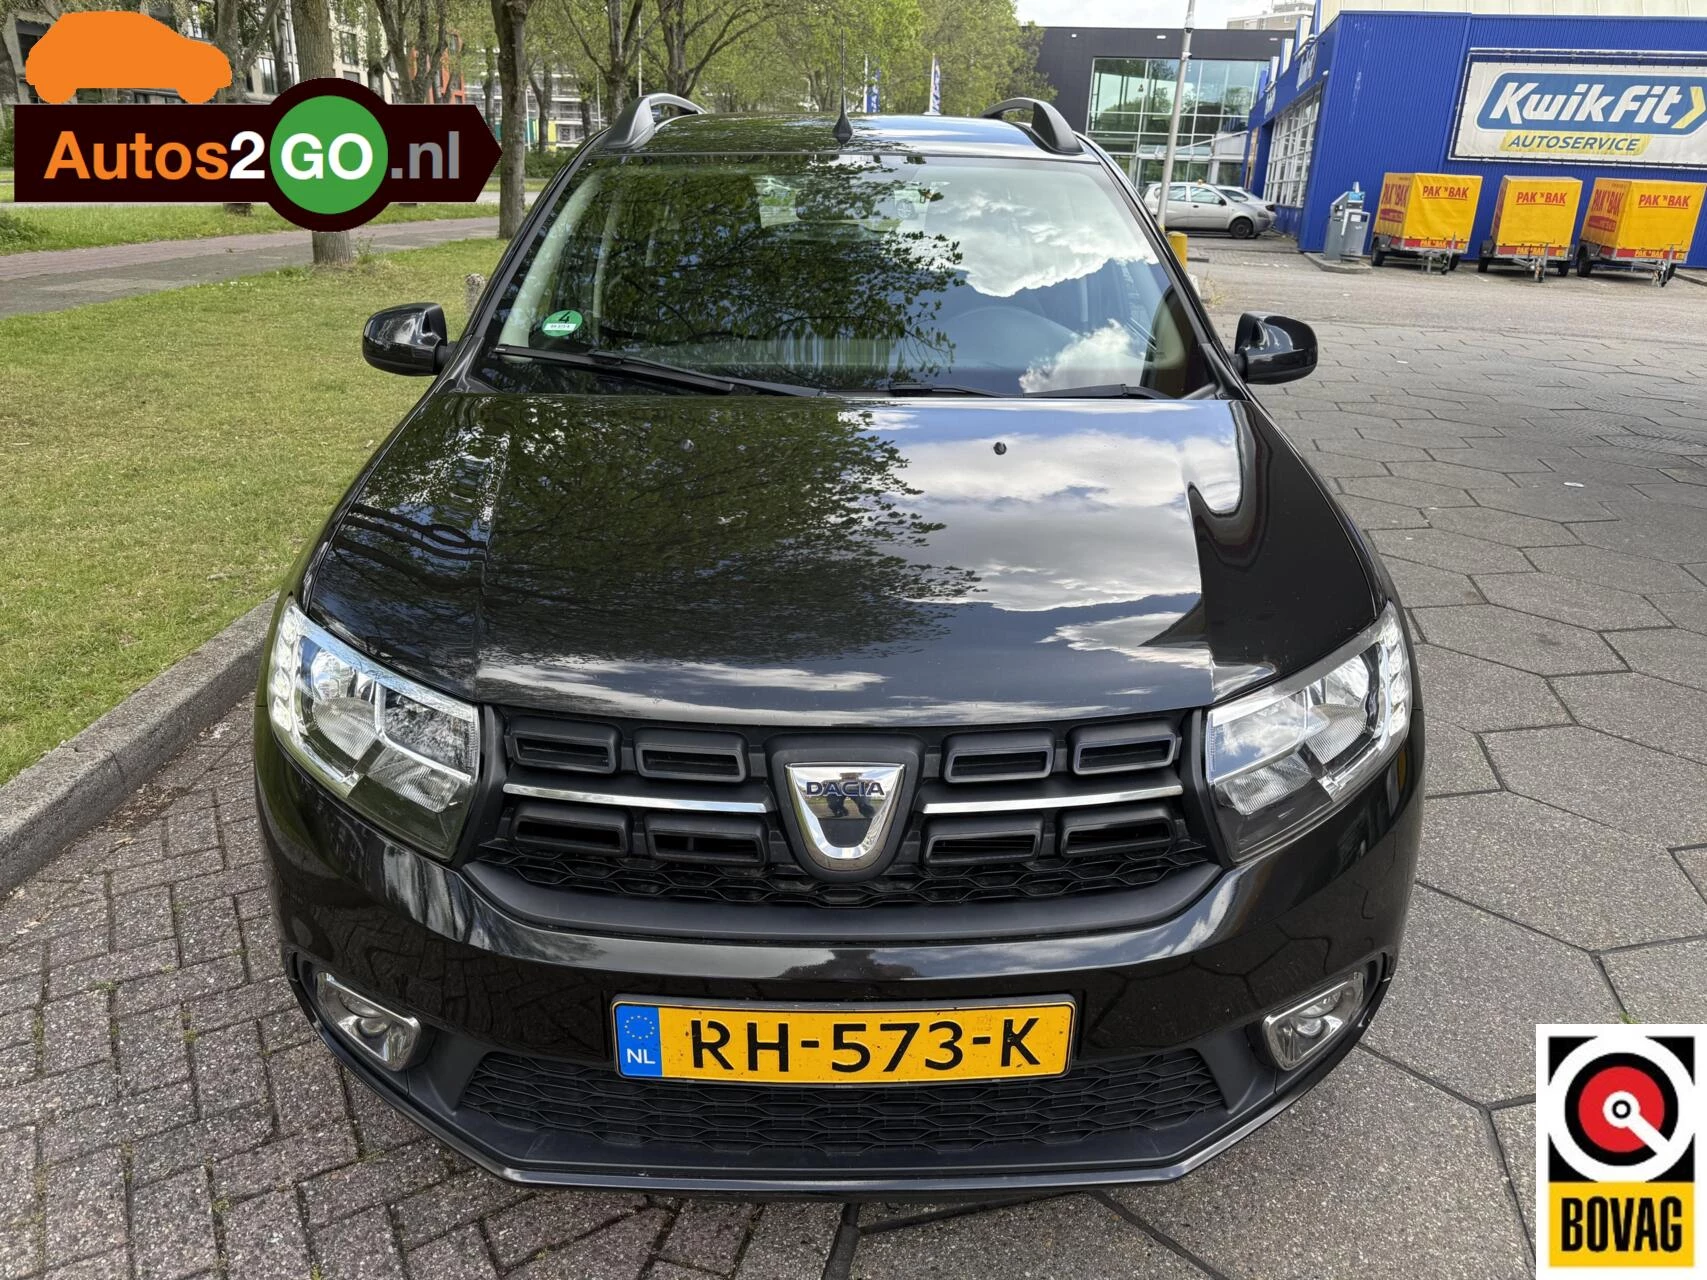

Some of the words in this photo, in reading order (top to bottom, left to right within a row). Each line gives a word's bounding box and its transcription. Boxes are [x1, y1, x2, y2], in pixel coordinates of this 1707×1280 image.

[1508, 134, 1641, 151] AUTOSERVICE
[1422, 185, 1441, 197] PAK
[1448, 187, 1470, 199] BAK
[1516, 191, 1538, 204] PAK
[1544, 192, 1568, 205] BAK
[1638, 194, 1661, 206] PAK
[1667, 195, 1692, 208] BAK
[558, 311, 570, 323] 4
[805, 781, 886, 796] DACIA
[690, 1017, 1041, 1073] RH-573-K
[626, 1048, 656, 1065] NL
